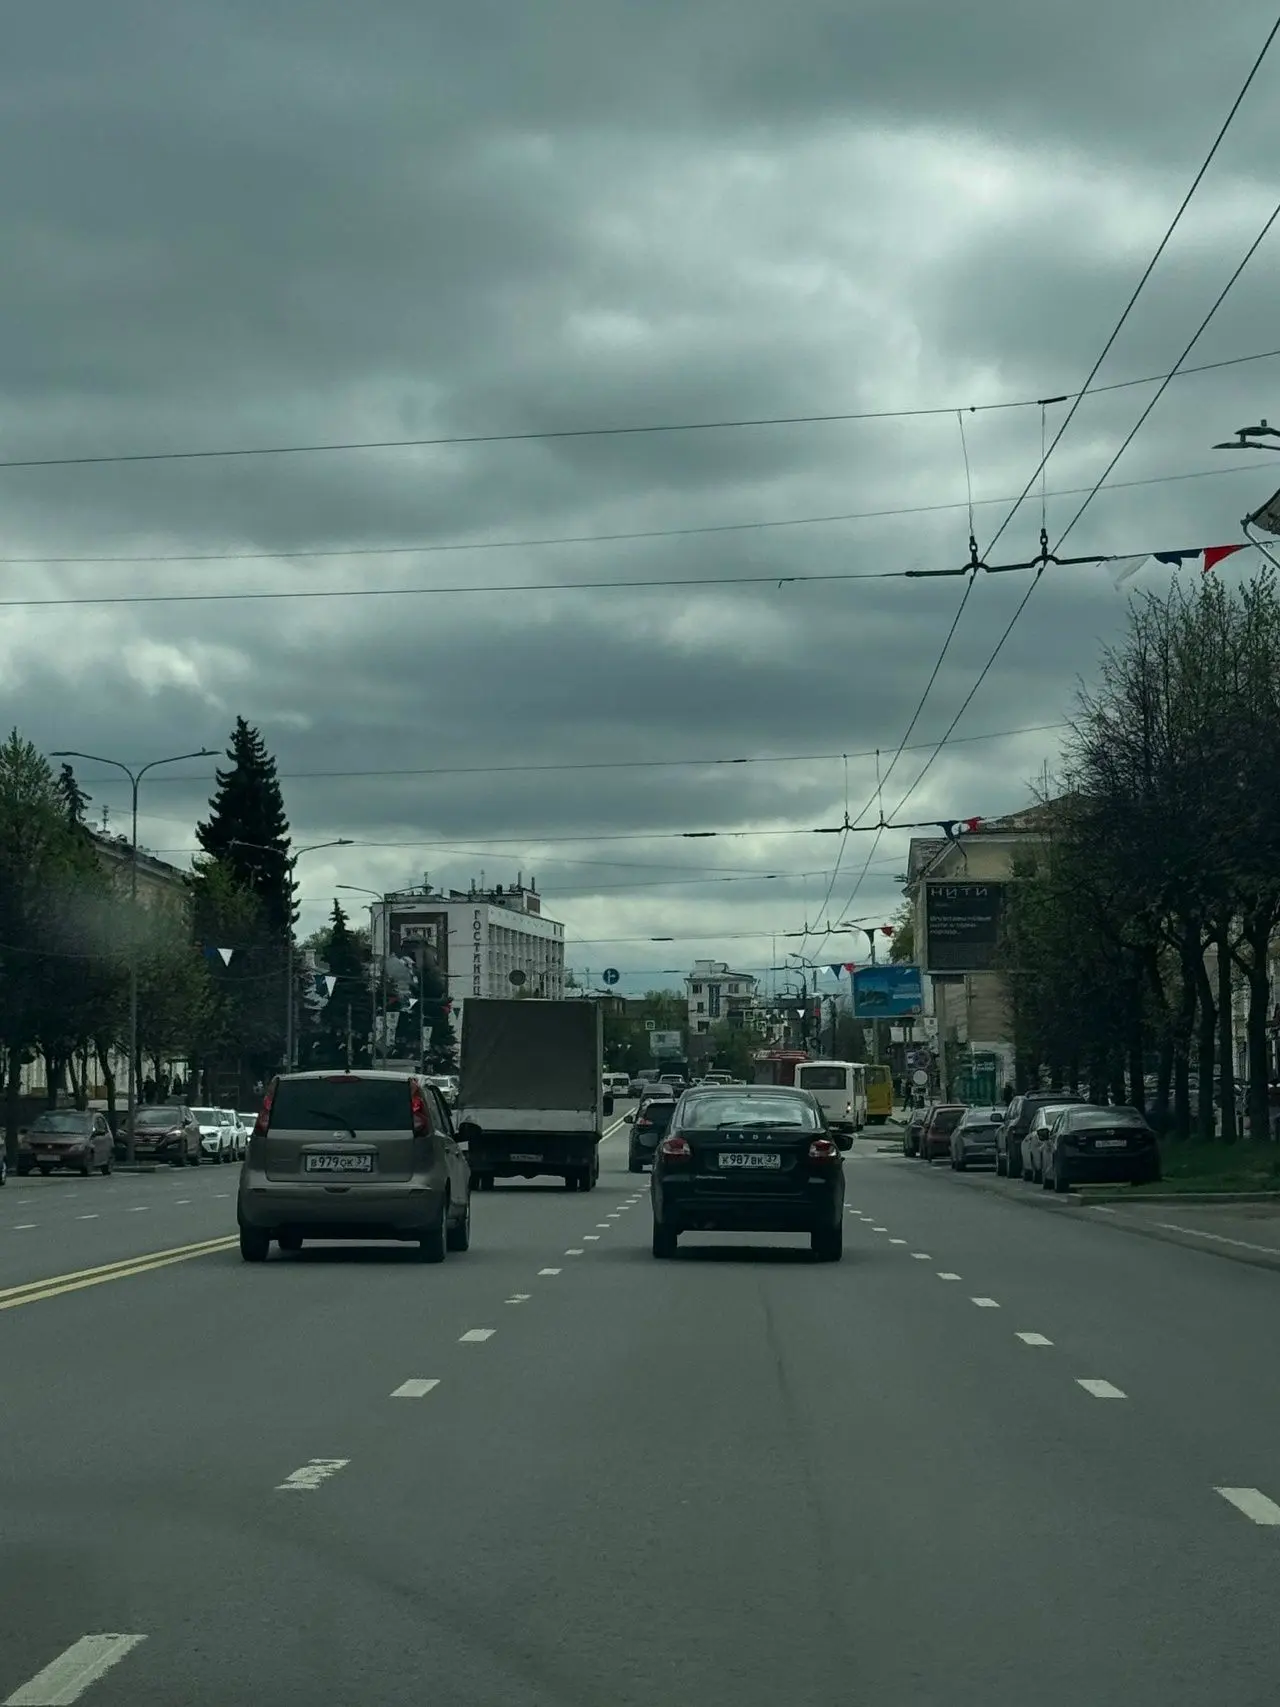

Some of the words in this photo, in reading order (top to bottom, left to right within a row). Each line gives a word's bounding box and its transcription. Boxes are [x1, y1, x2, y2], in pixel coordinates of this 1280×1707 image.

[930, 887, 988, 898] НИТИ
[472, 909, 482, 996] ГОСТИНИЦ
[725, 1133, 773, 1141] LADA
